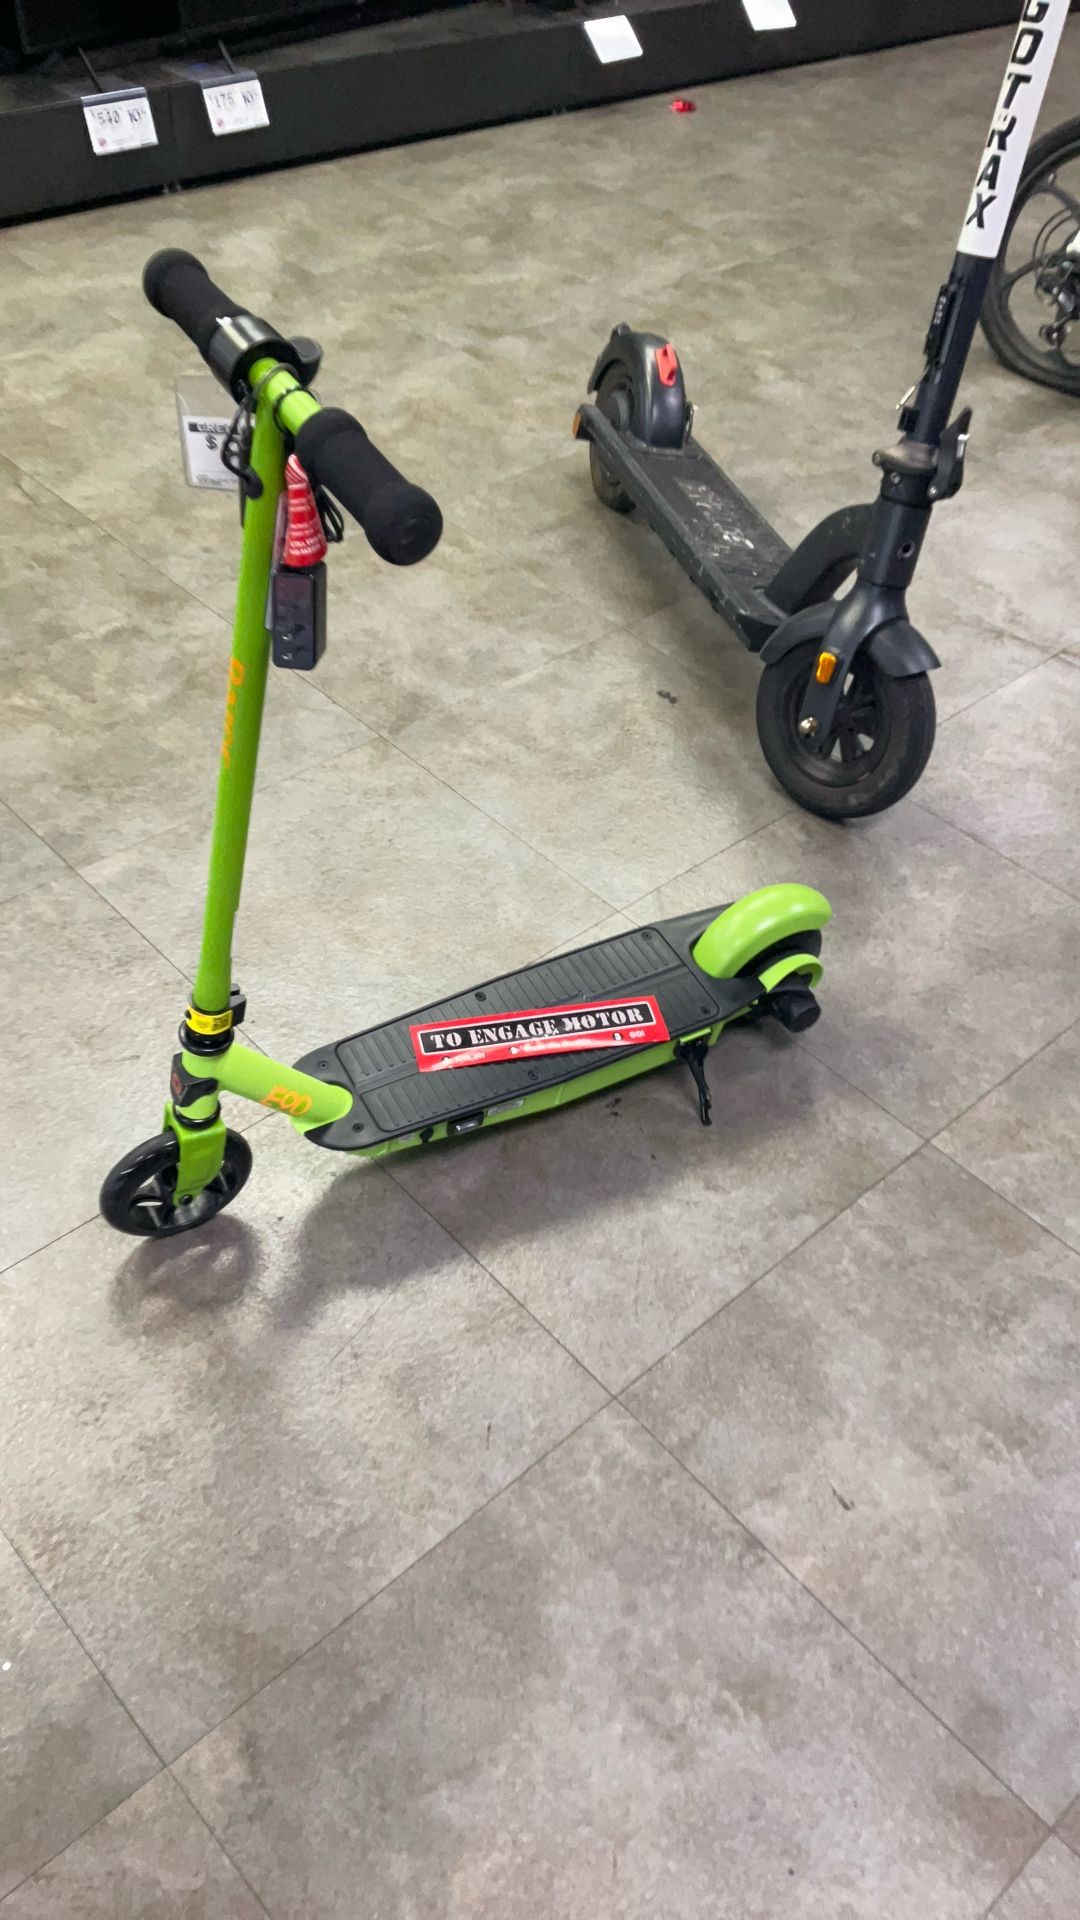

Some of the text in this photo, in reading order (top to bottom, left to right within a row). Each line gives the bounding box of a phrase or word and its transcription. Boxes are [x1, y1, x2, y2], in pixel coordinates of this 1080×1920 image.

[429, 1030, 463, 1050] TO
[467, 1018, 557, 1046] ENGAGE
[562, 1007, 645, 1033] MOTOR
